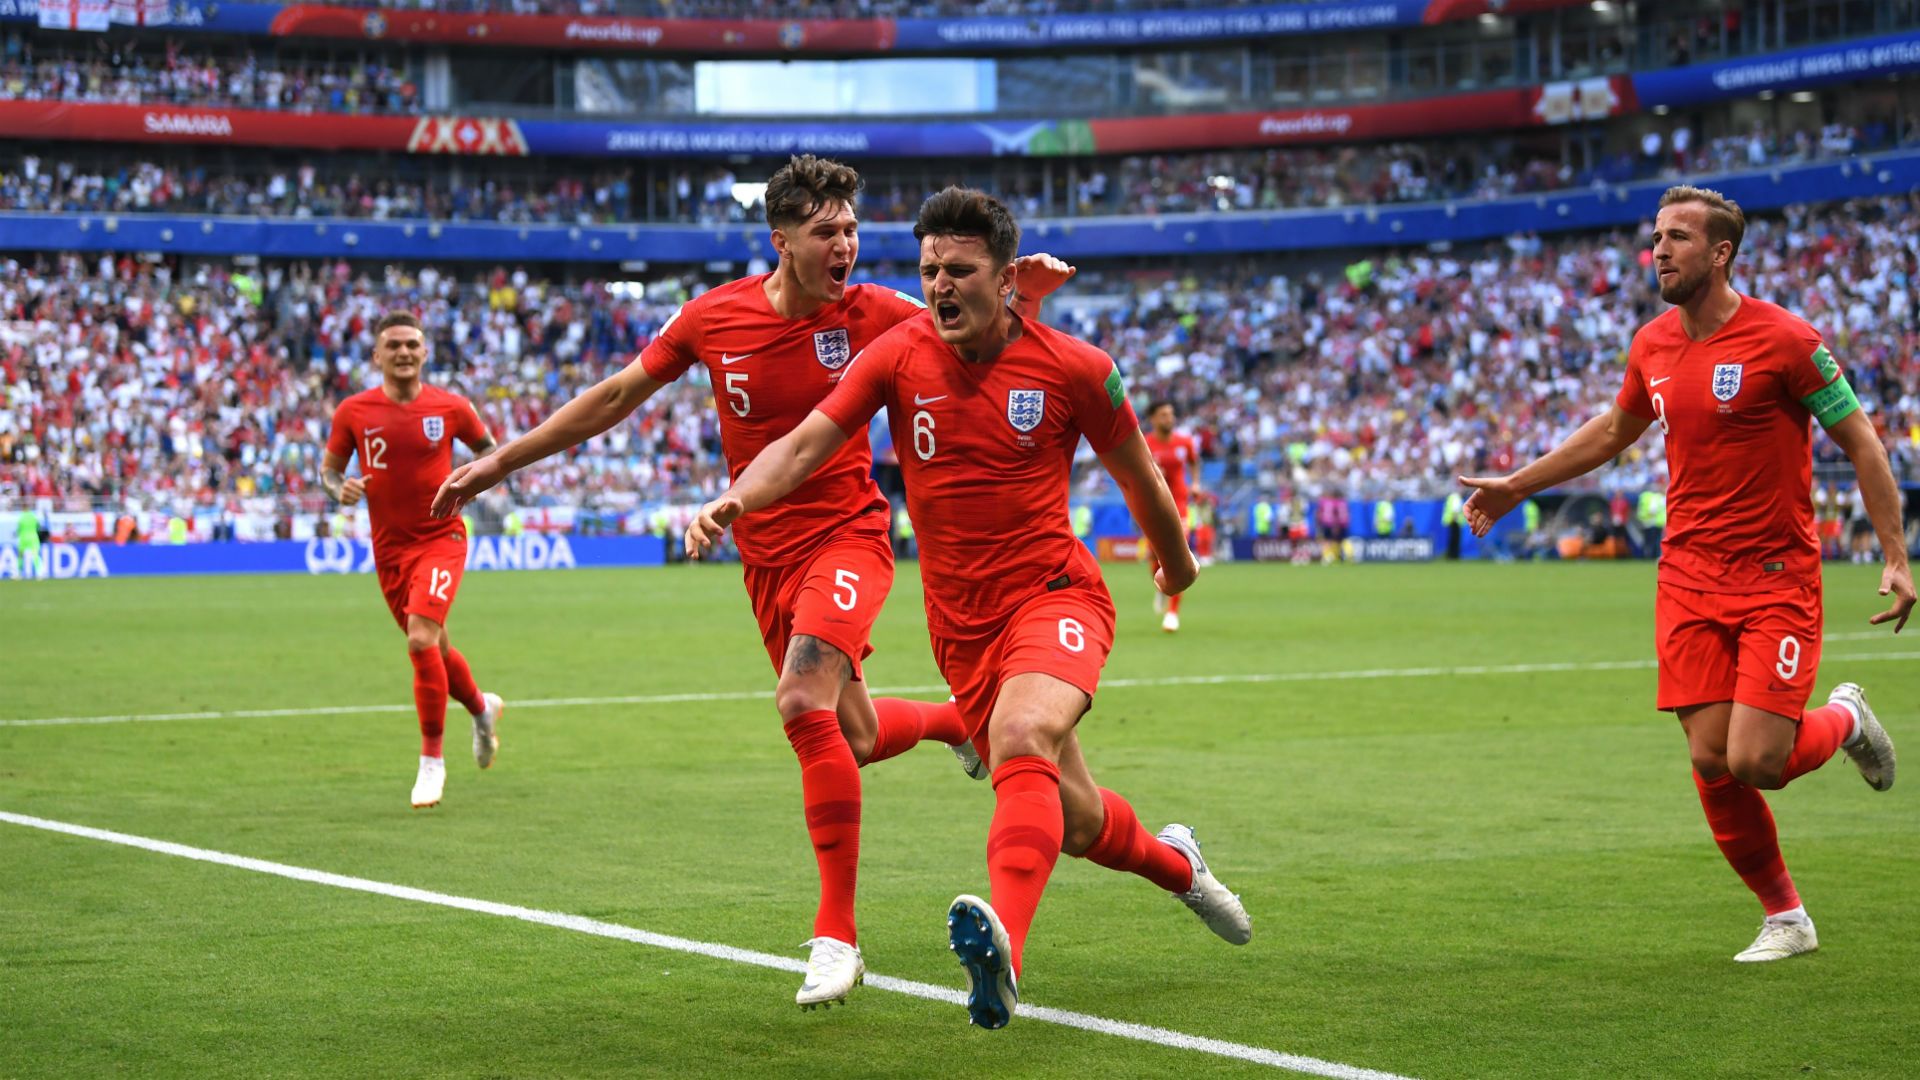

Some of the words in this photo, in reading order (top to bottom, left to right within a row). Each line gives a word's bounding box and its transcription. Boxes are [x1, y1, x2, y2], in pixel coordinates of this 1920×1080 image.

[145, 112, 232, 136] SAMARA
[725, 372, 750, 418] 5
[1651, 392, 1669, 436] 9
[365, 437, 387, 469] 12
[913, 410, 936, 461] 6
[429, 567, 452, 601] 12
[833, 569, 860, 611] 5
[1058, 617, 1085, 652] 6
[1776, 635, 1800, 680] 9
